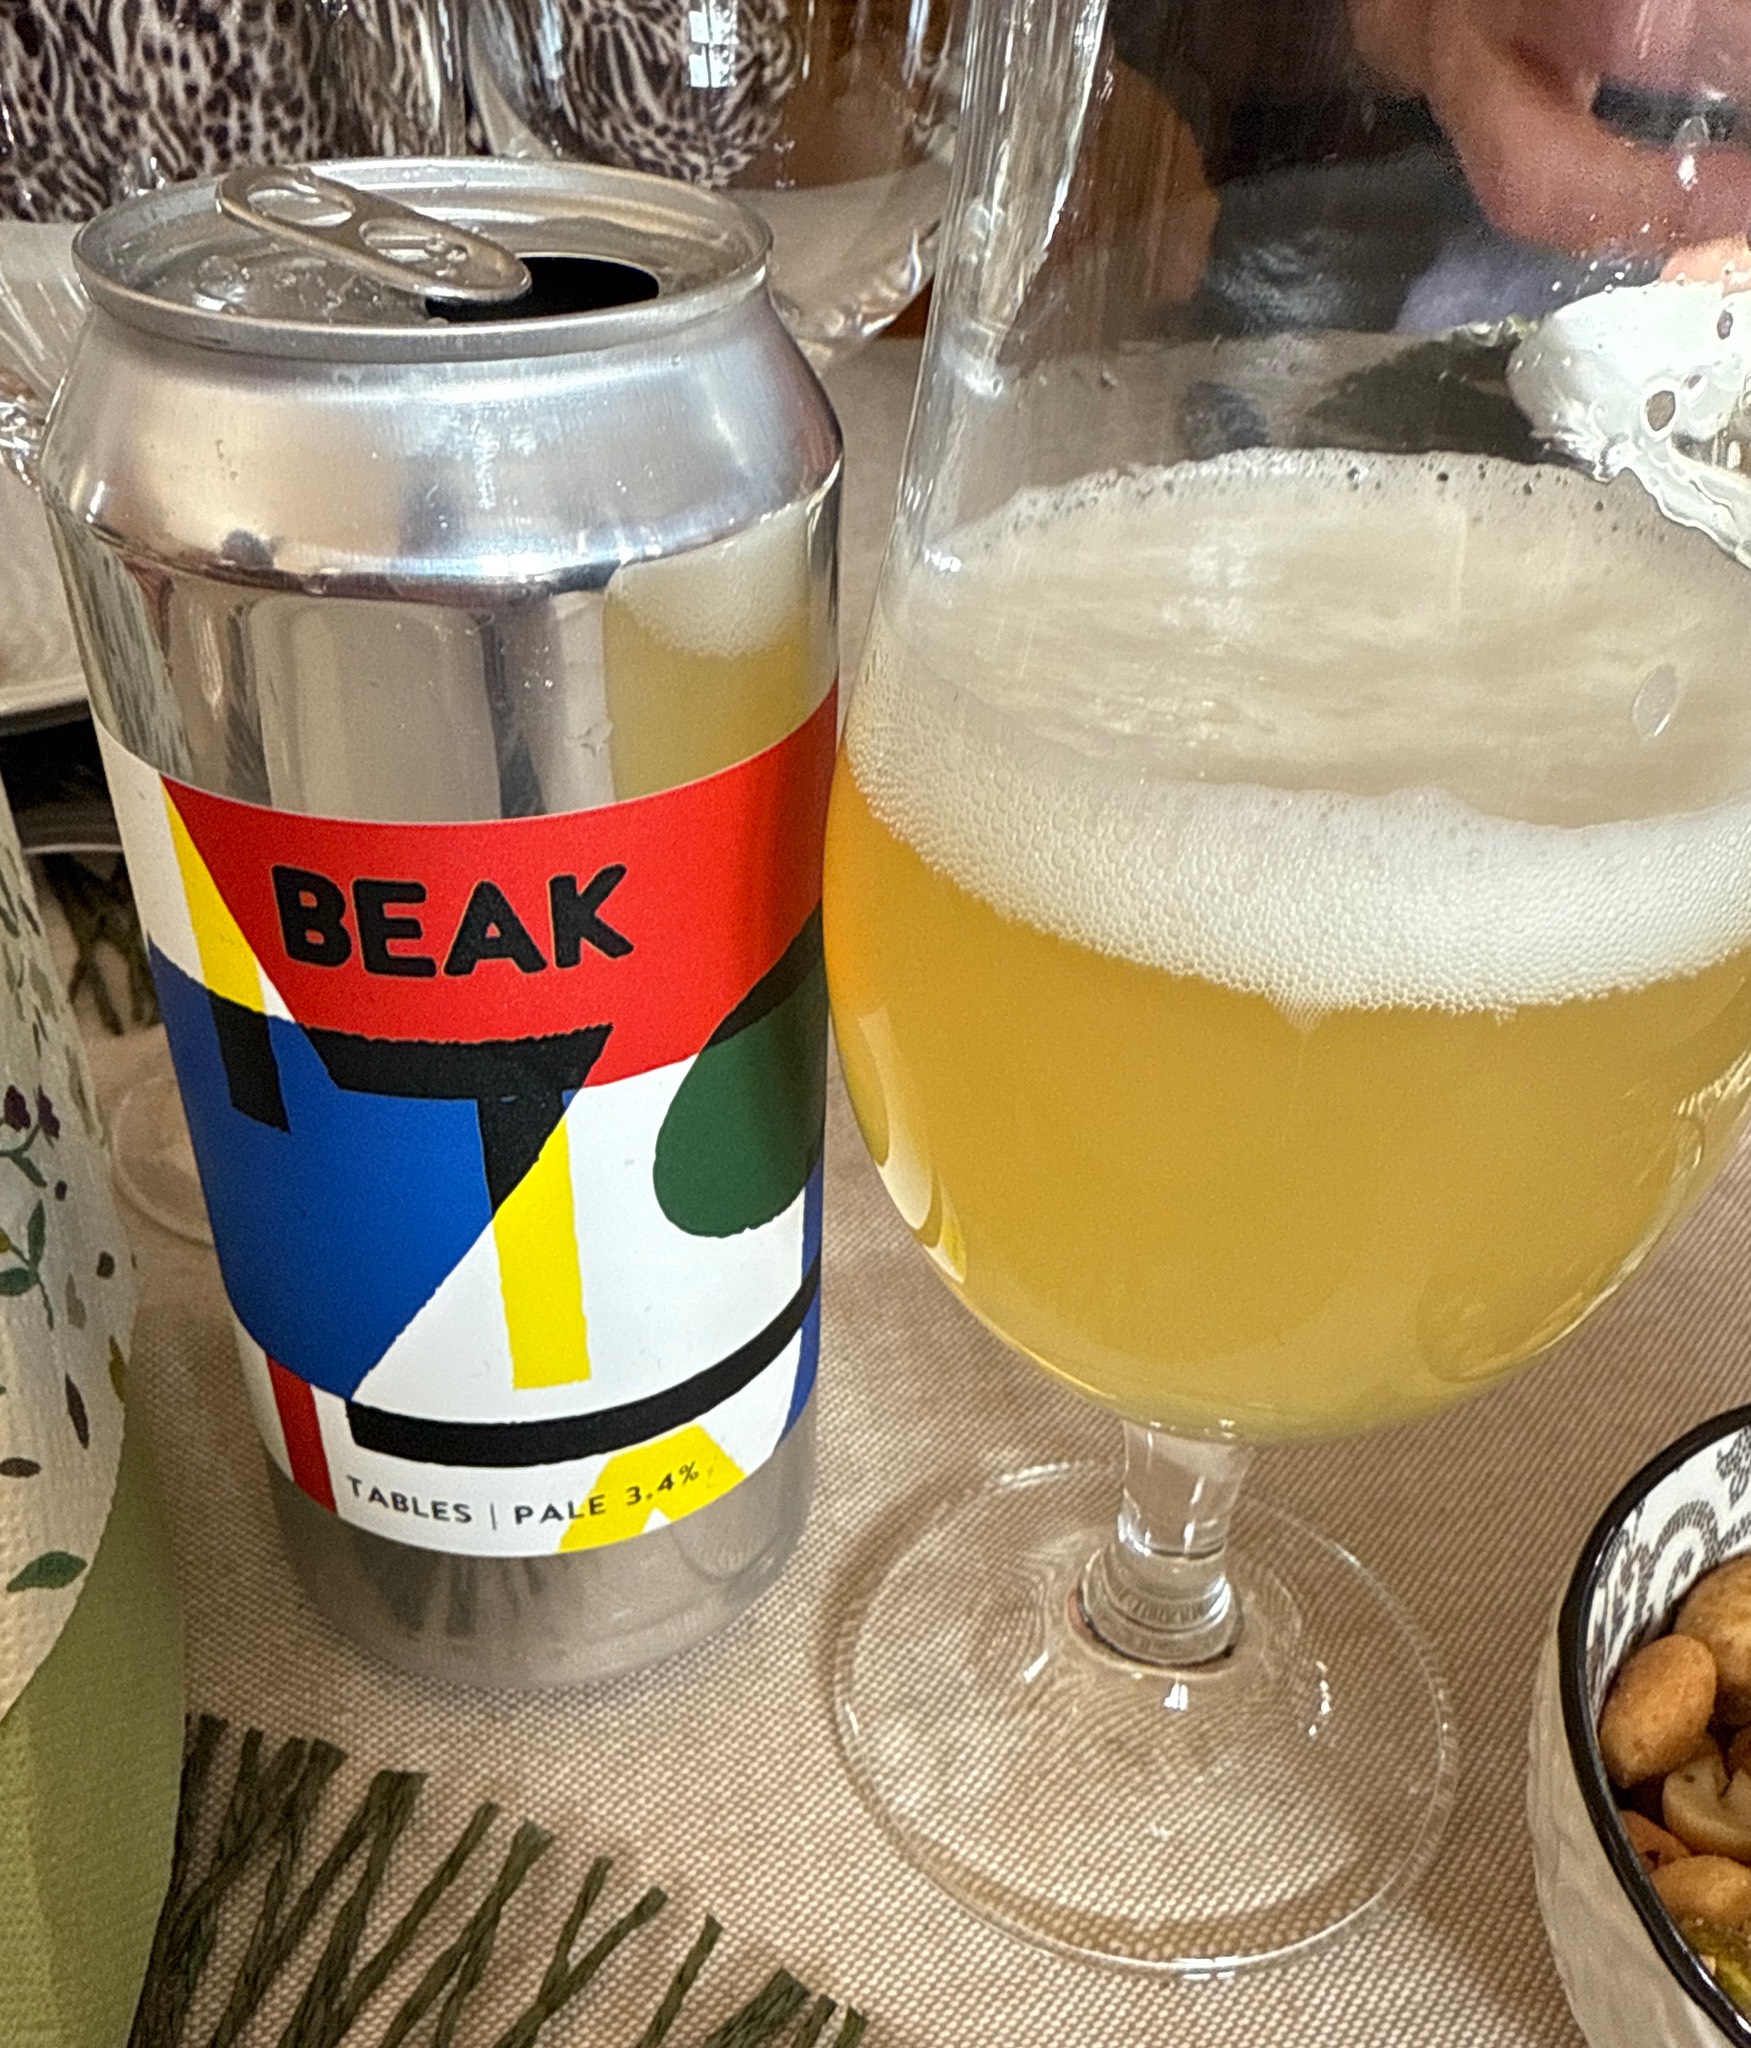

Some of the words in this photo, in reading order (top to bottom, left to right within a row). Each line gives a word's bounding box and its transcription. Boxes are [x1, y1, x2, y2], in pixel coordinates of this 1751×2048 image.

[271, 864, 634, 978] BEAK
[346, 1475, 472, 1524] TABLES
[514, 1495, 606, 1525] PALE
[626, 1461, 700, 1506] 3.4%
